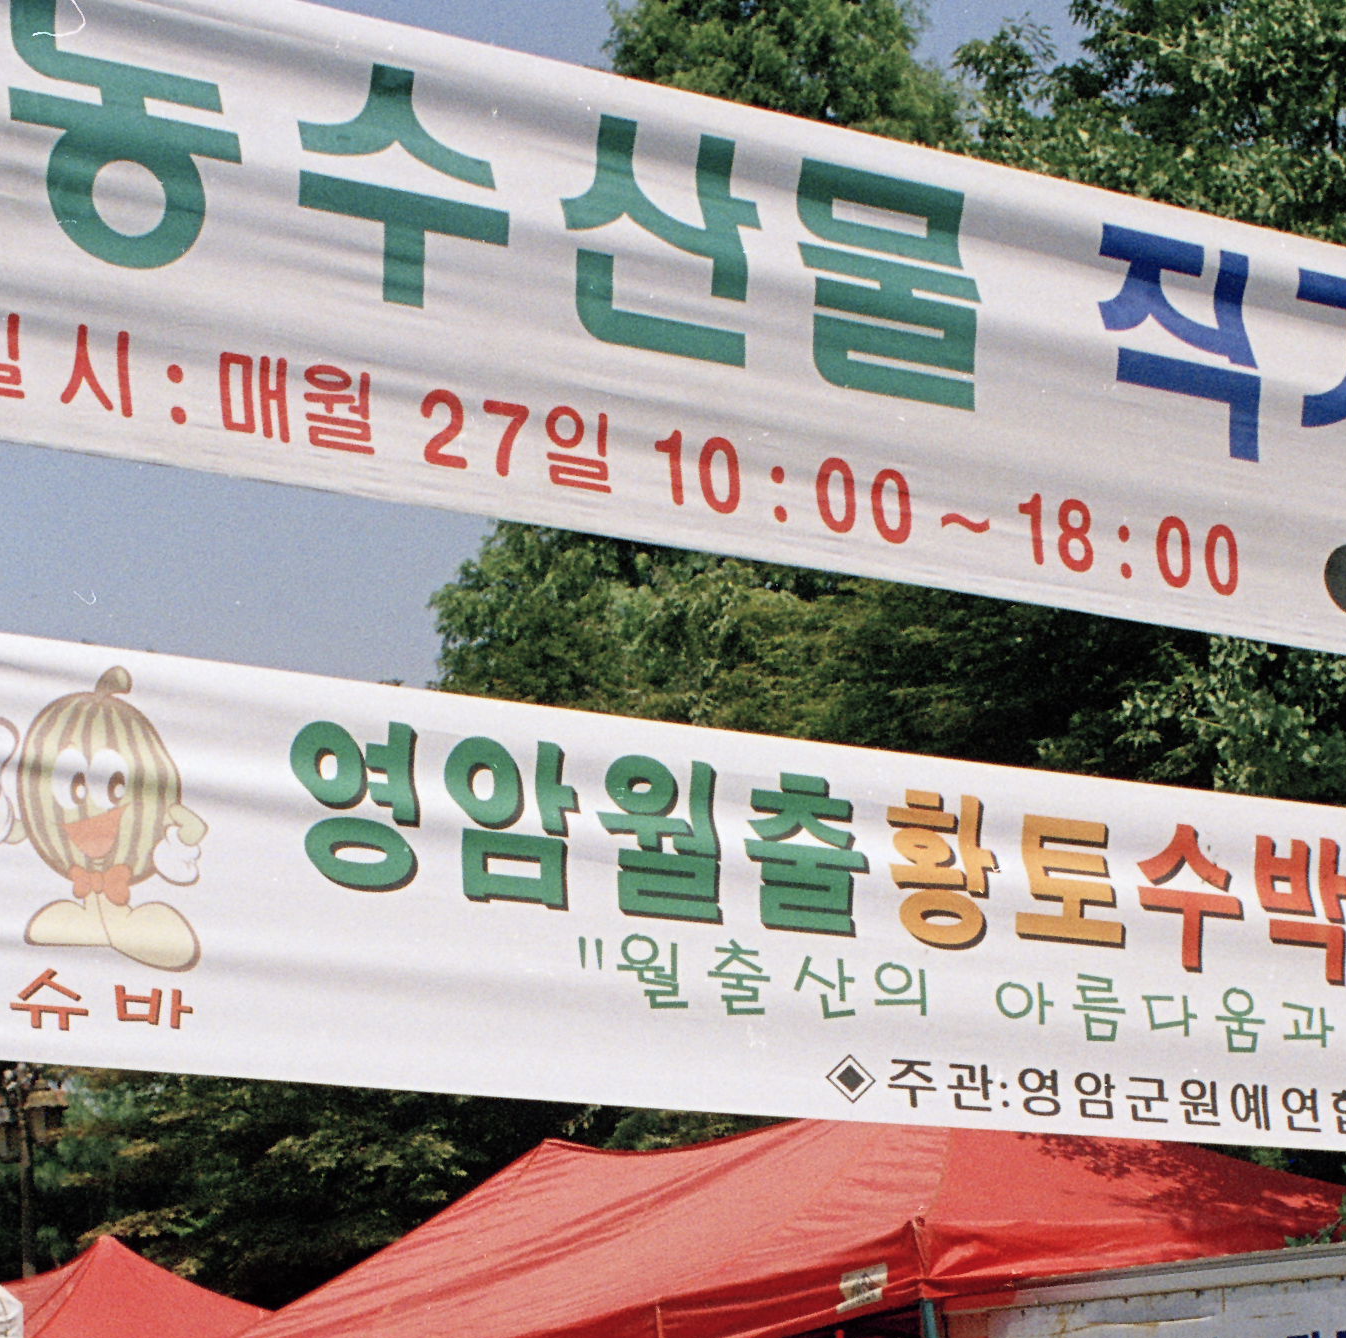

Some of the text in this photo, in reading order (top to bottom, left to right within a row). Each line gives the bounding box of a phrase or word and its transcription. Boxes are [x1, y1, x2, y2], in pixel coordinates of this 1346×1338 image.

[9, 0, 982, 411] 농수산물
[420, 388, 613, 495] 27일
[654, 429, 1240, 597] 10:00~18:00
[9, 967, 195, 1032] 슈바
[996, 972, 1336, 1054] 아름다움과
